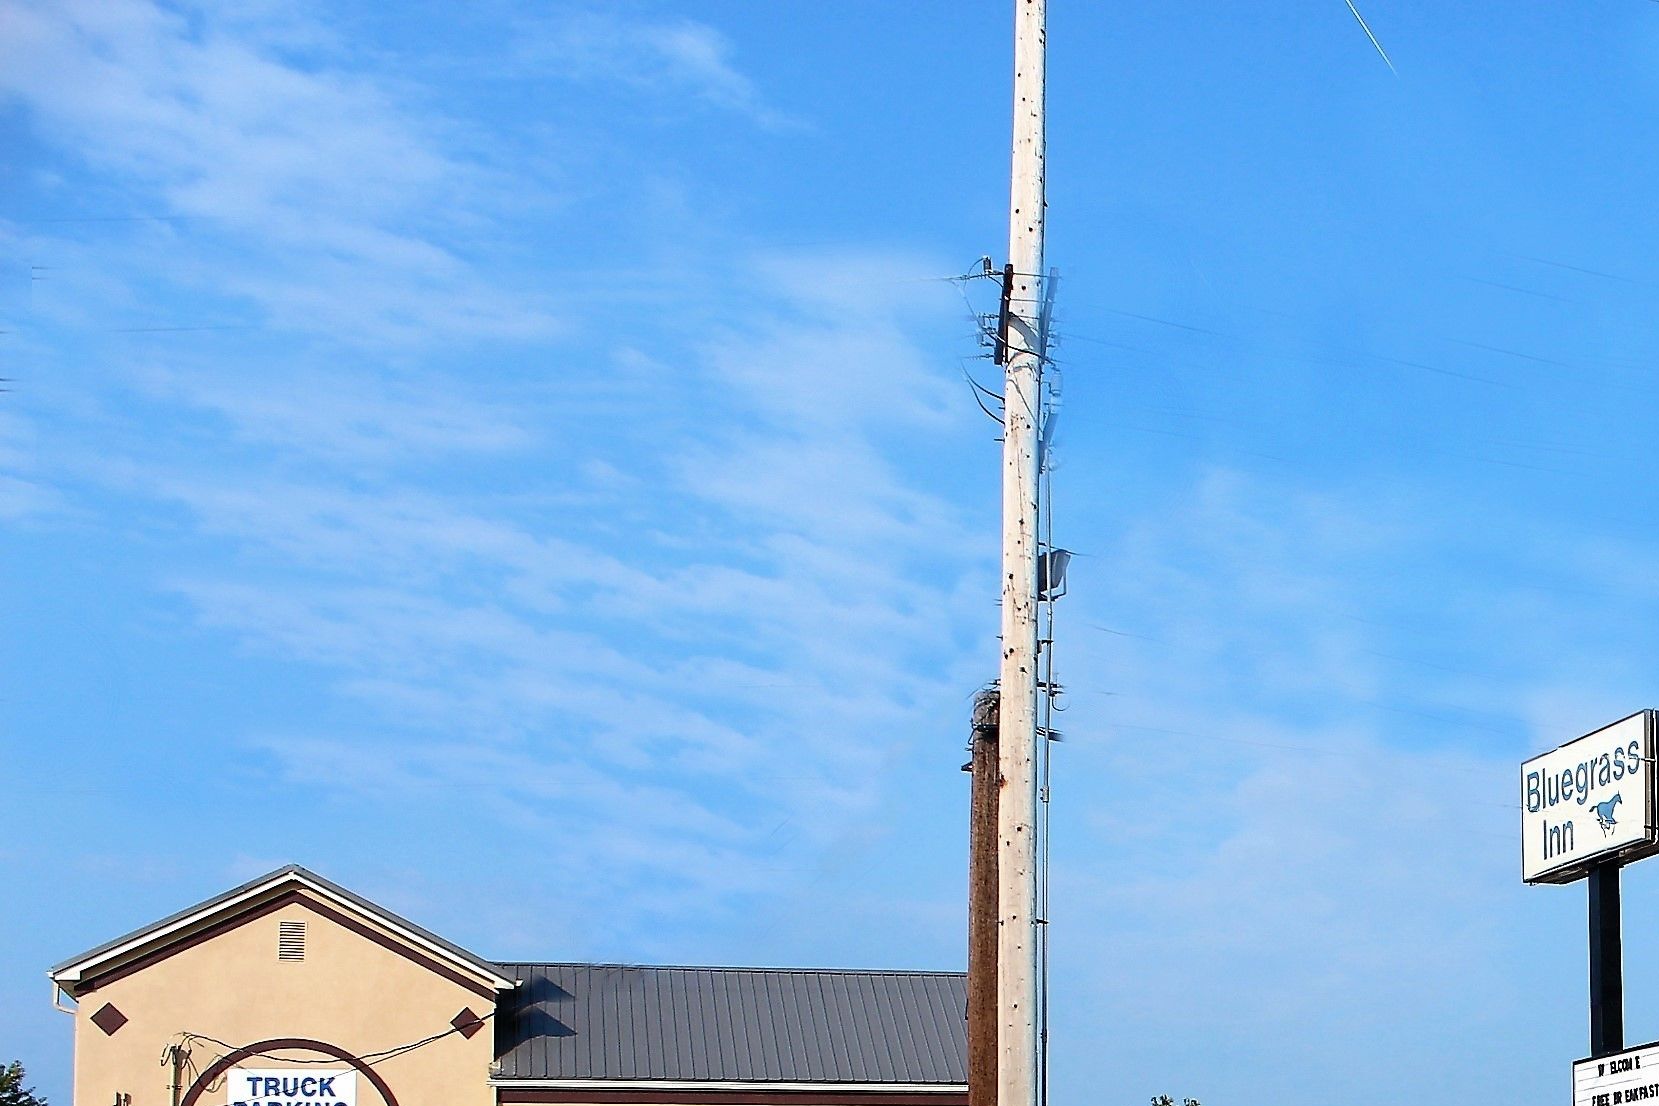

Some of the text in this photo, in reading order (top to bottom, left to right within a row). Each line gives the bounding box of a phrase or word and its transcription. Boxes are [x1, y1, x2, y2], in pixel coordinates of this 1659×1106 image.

[1526, 740, 1641, 813] Bluegrass
[1543, 819, 1574, 860] Inn
[246, 1076, 336, 1098] TRUCK
